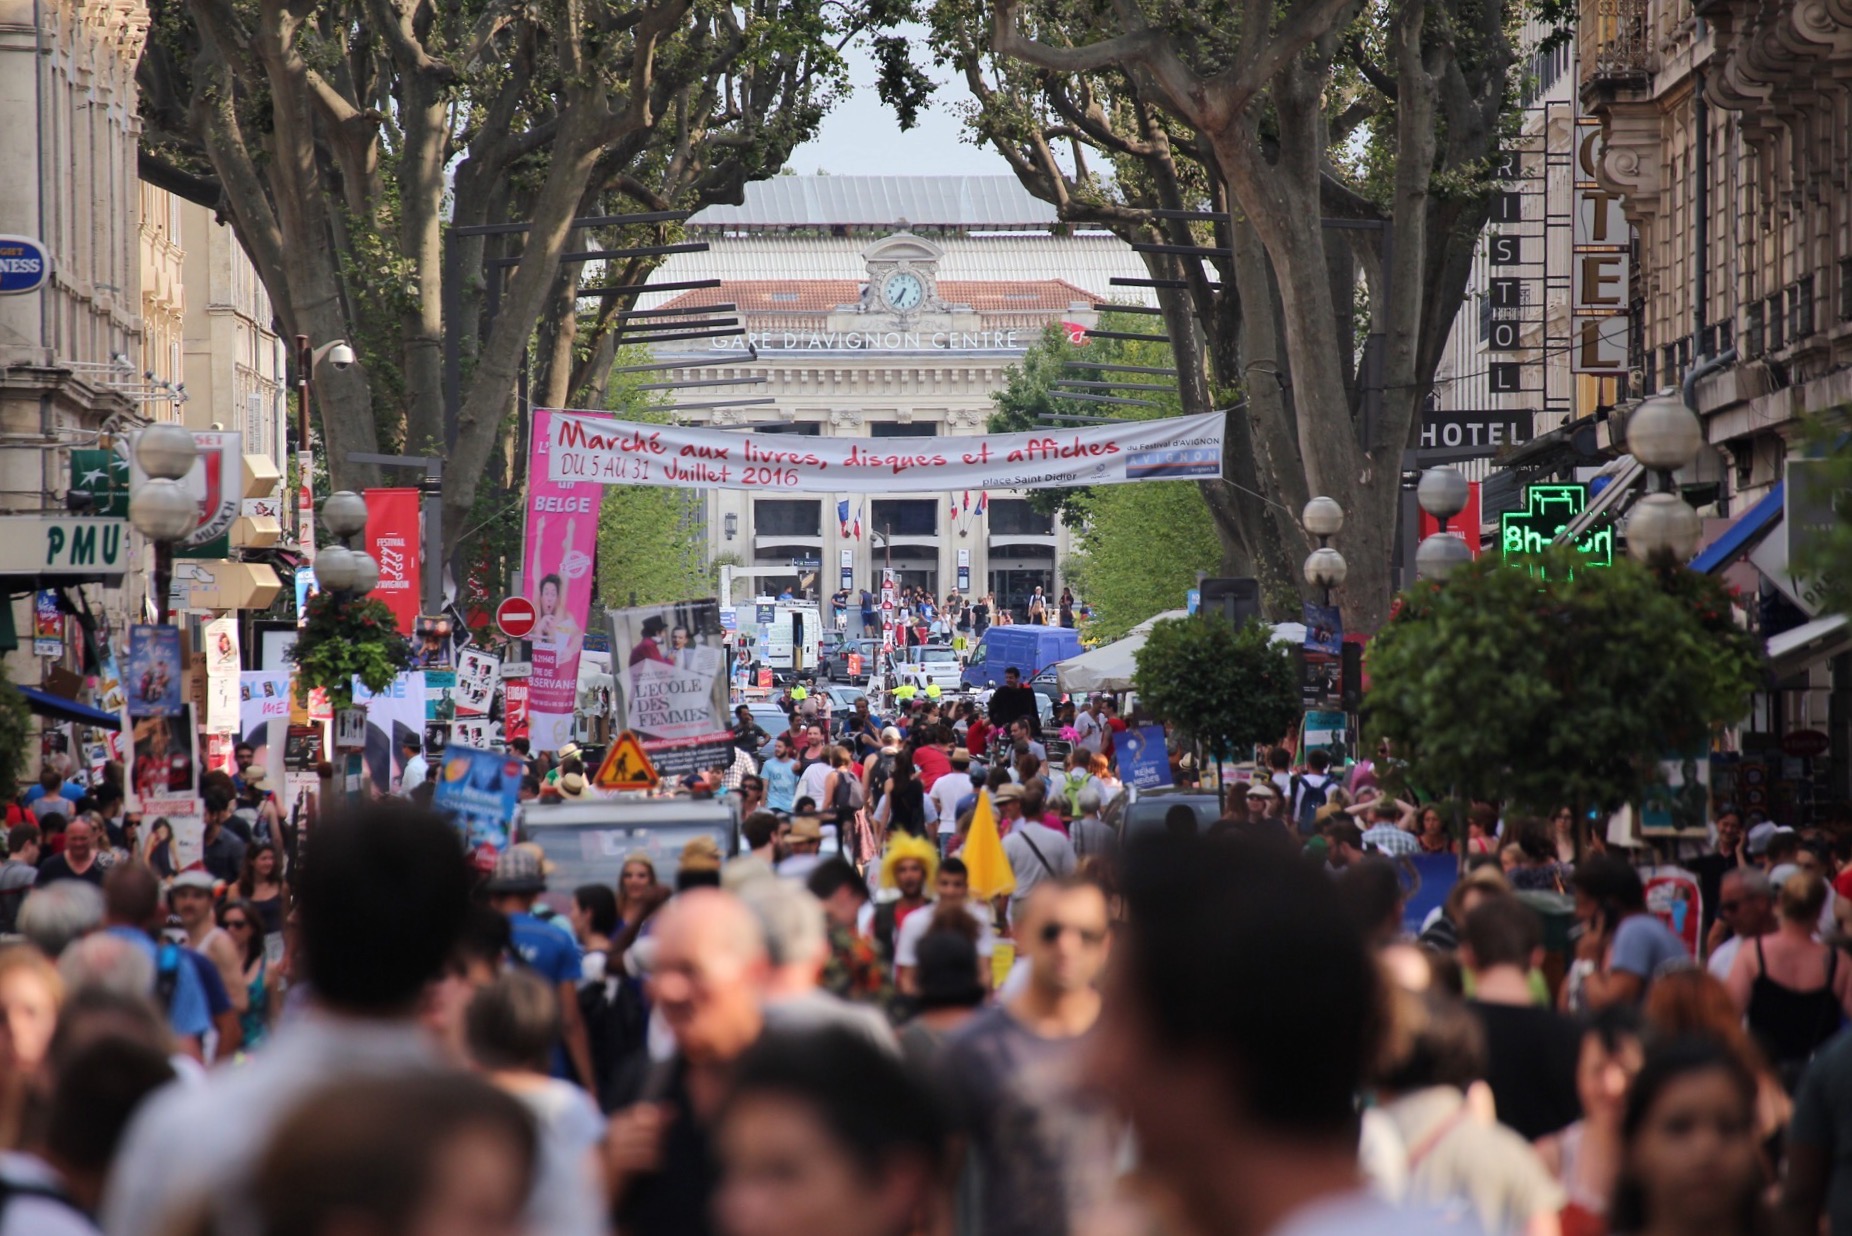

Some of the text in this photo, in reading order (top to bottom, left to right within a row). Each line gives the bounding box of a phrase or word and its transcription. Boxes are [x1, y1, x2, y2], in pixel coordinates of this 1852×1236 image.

[711, 331, 1018, 350] GARE D'AVIGNON CENTRE
[1421, 423, 1525, 446] HOTEL
[558, 420, 1120, 475] Marché aux livres, disques et affiches
[1139, 440, 1171, 450] Festival
[1173, 438, 1220, 447] d'AVIGNON
[1129, 450, 1217, 466] AVIGNON
[561, 453, 799, 486] DU 5 AU 31 Juillet 2016
[982, 471, 1077, 487] place Saint Didier
[534, 495, 591, 513] BELGE
[46, 523, 121, 565] PMU
[636, 680, 702, 698] L'ECOLE
[638, 697, 670, 713] DES
[639, 708, 709, 727] FEMMES
